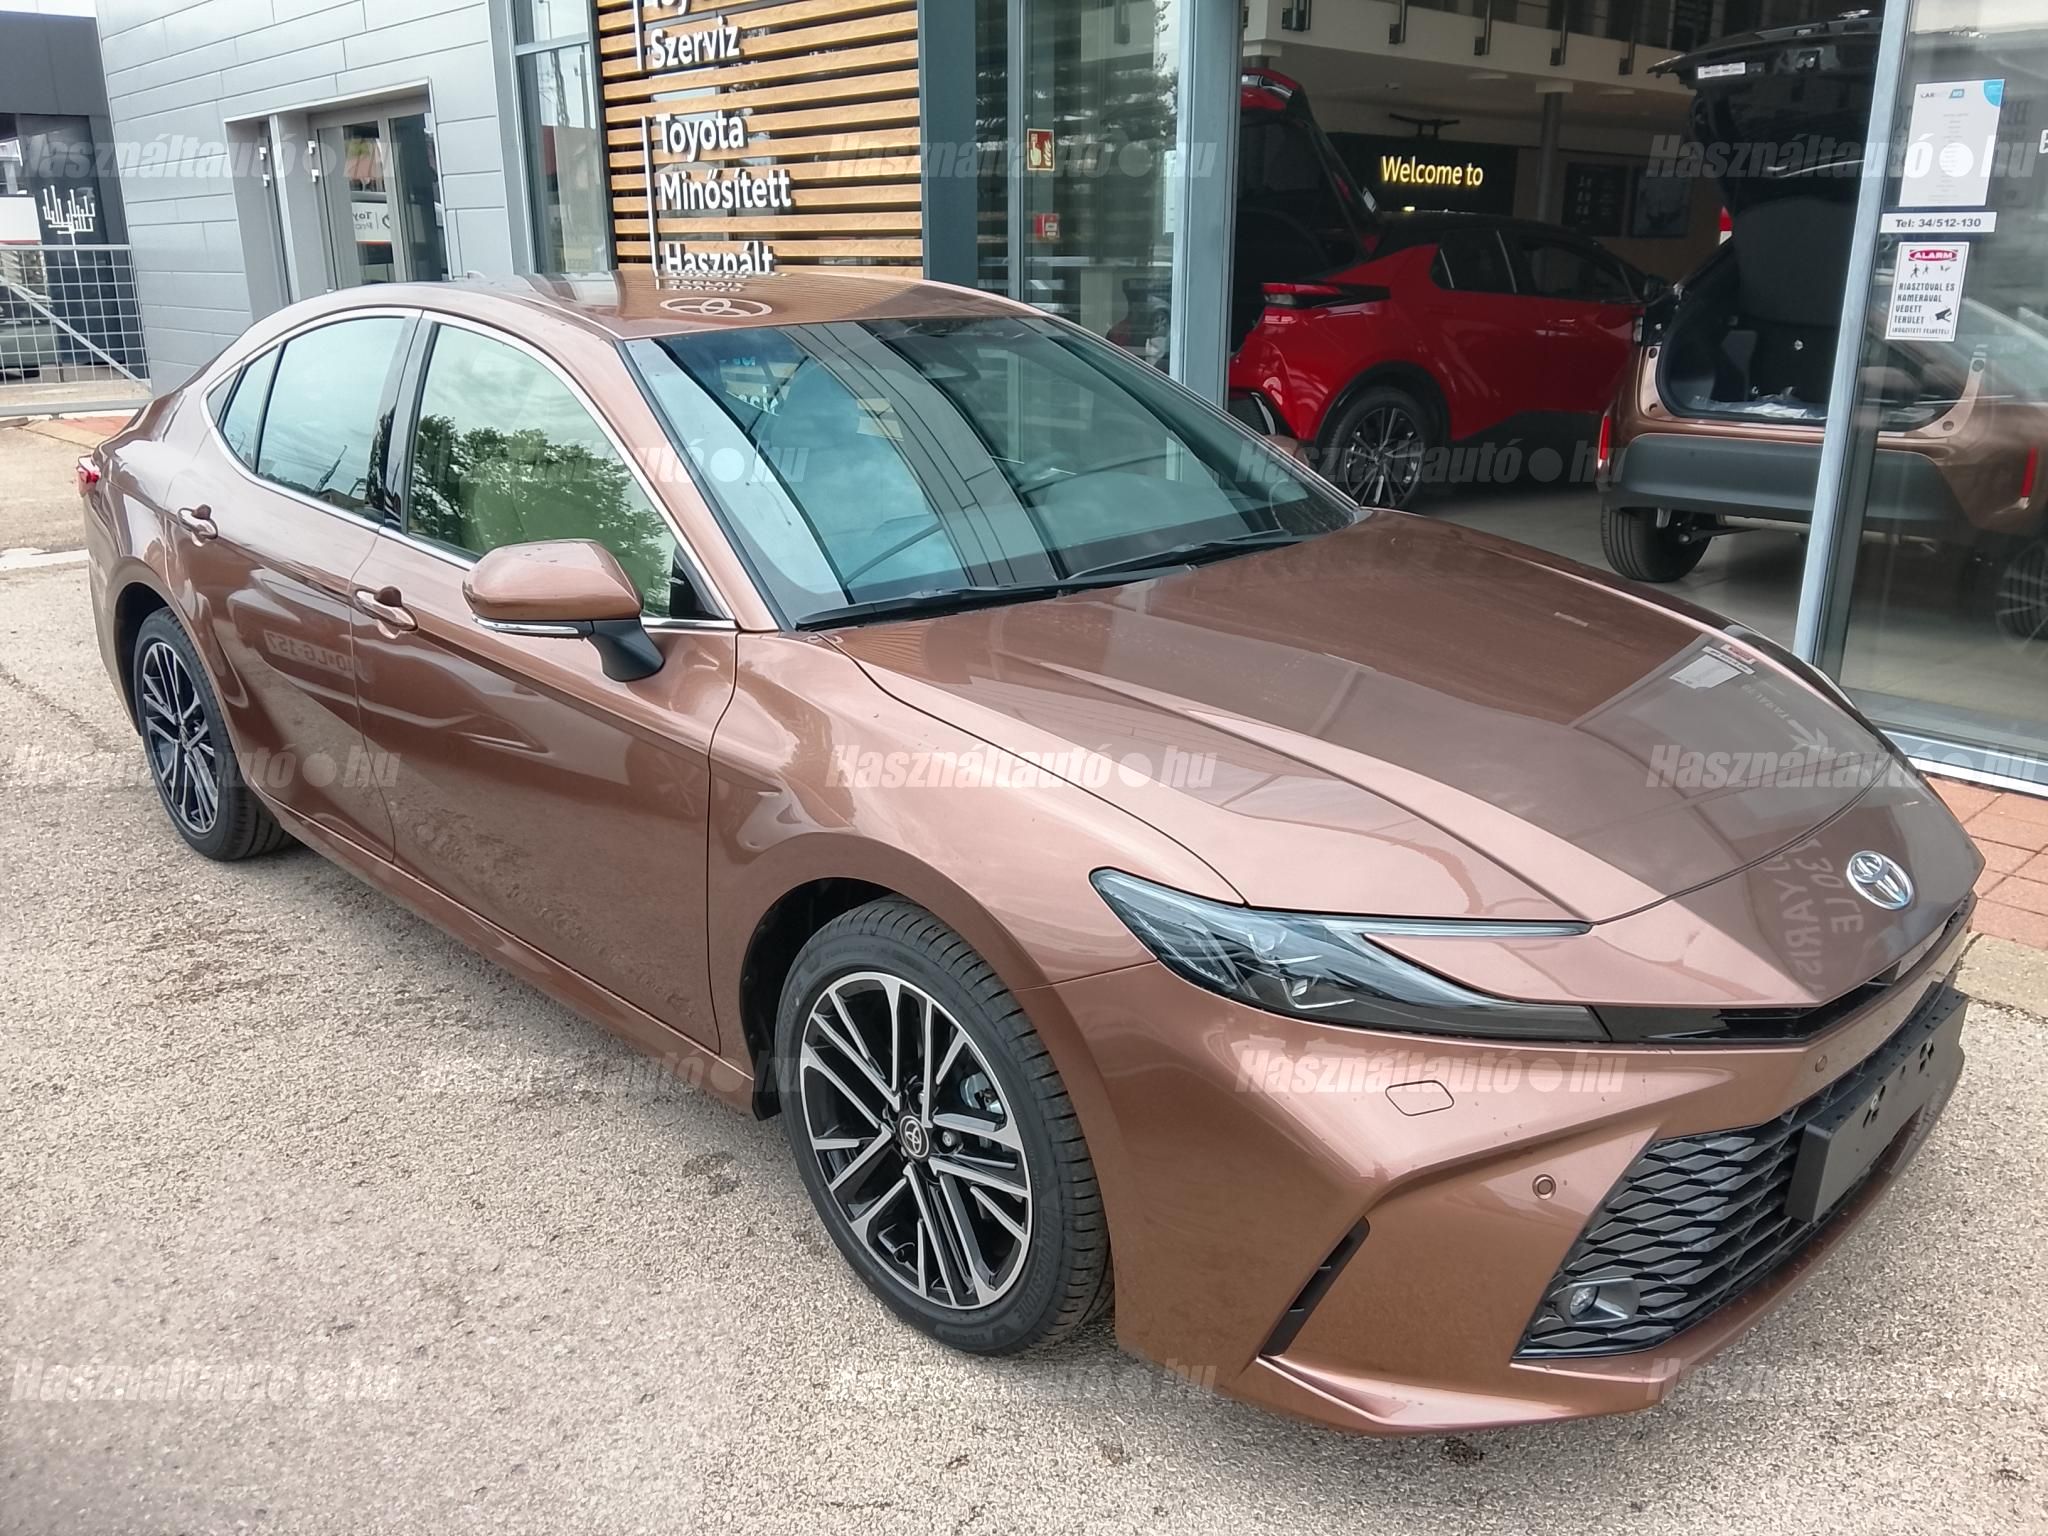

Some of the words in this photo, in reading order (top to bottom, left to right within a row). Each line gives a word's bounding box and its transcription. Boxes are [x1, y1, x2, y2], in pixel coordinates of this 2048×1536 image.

[651, 15, 741, 68] Szerviz
[656, 110, 745, 162] Toyota
[1381, 155, 1463, 186] Welcome
[1465, 163, 1484, 186] to
[660, 168, 793, 210] Minősített
[1896, 218, 1915, 228] Tel:
[1918, 218, 1982, 228] 34/512-130
[665, 241, 774, 274] Használt
[1913, 251, 1954, 260] ALARM
